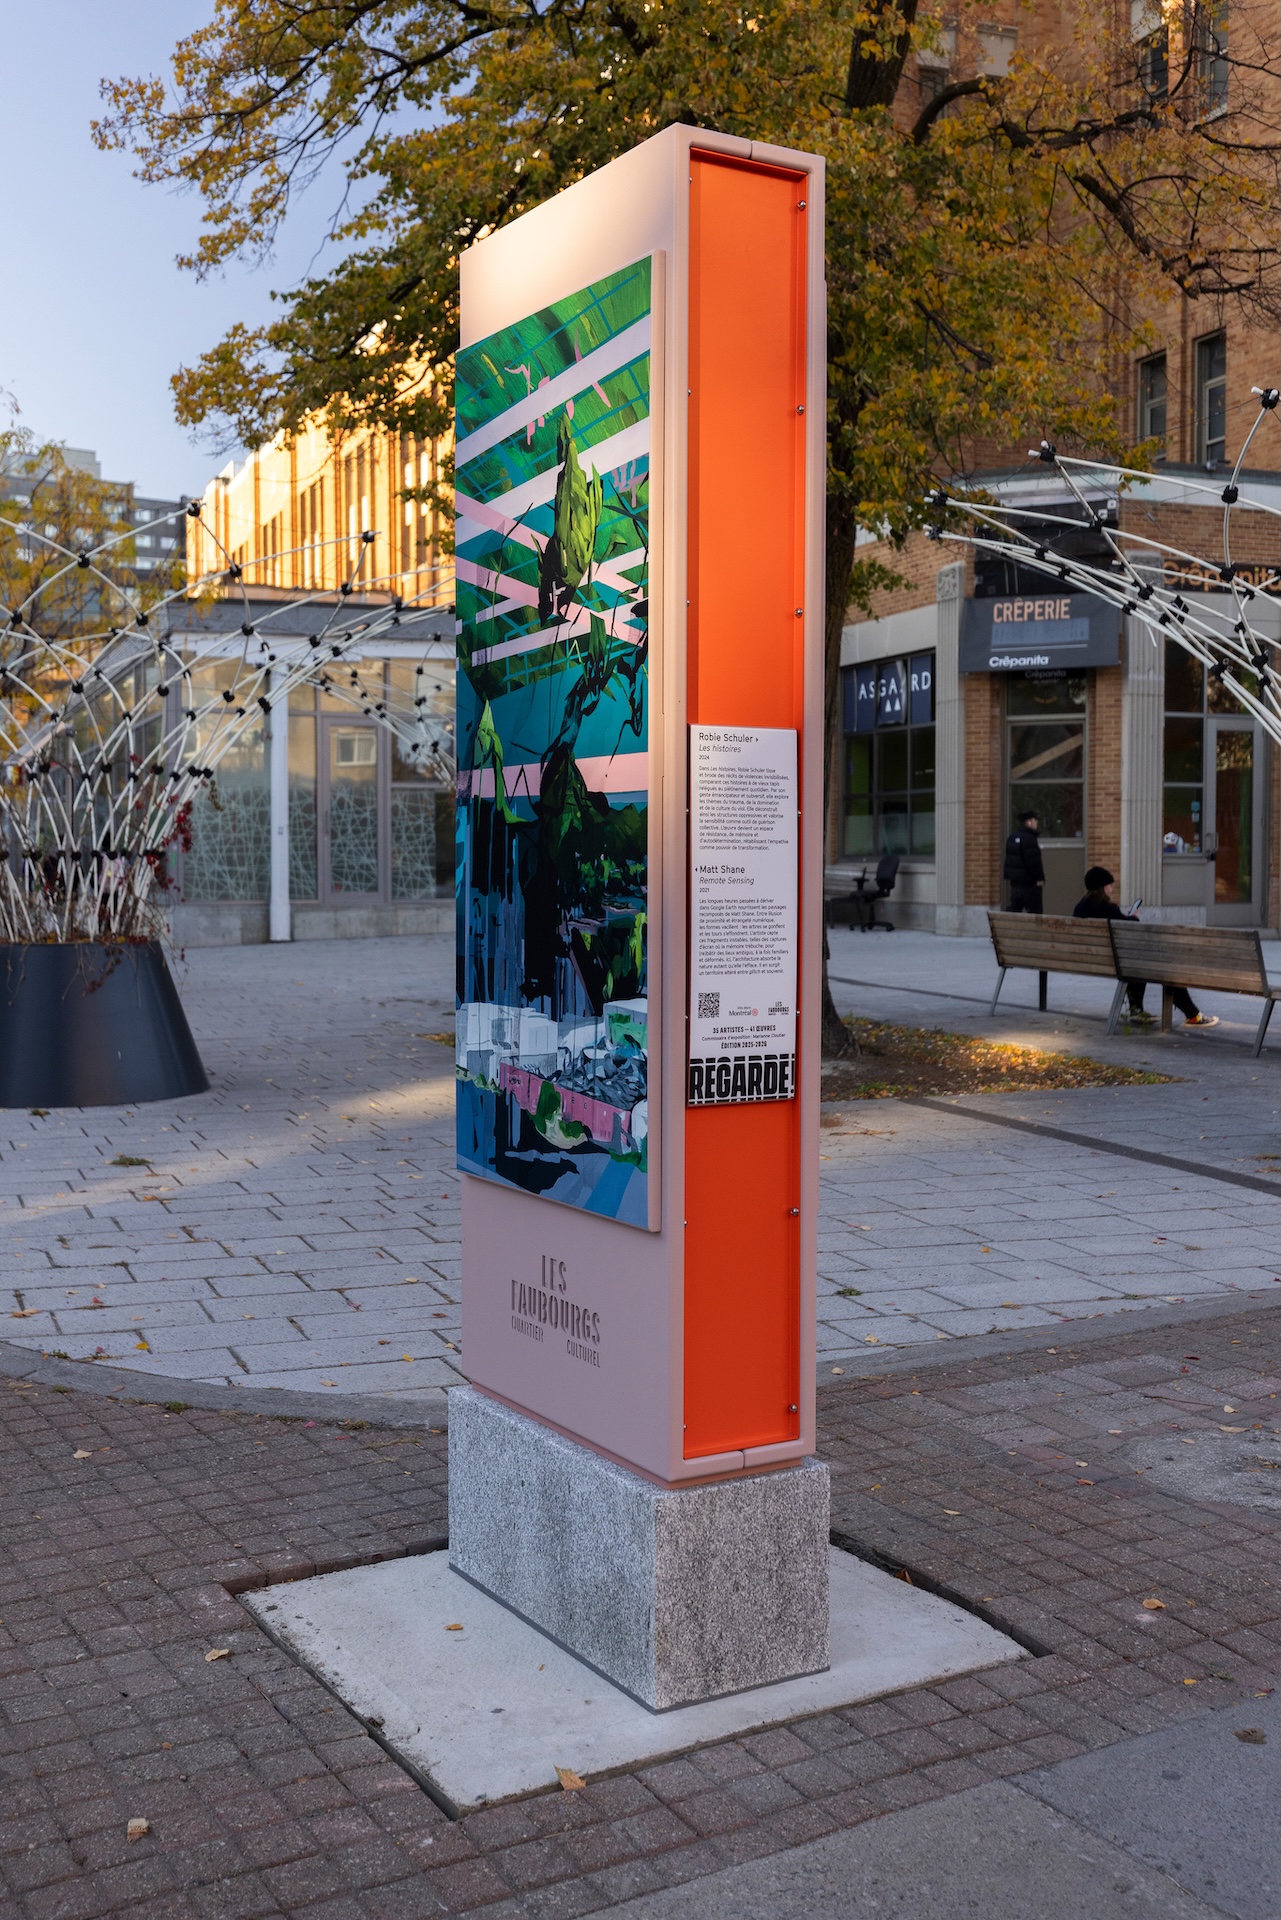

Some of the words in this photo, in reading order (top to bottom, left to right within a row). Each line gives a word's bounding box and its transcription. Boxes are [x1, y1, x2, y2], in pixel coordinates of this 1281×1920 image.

[993, 597, 1071, 623] CRÊPERIE
[989, 655, 1049, 668] Crêpanita
[859, 671, 931, 700] ASGARD
[699, 733, 721, 741] Robie
[724, 734, 753, 742] Schuler
[728, 877, 754, 885] Sensing
[541, 1254, 567, 1295] LES
[511, 1279, 601, 1346] FAUBOURGS
[512, 1316, 544, 1342] QUARTIER
[567, 1339, 600, 1368] CULTUREL
